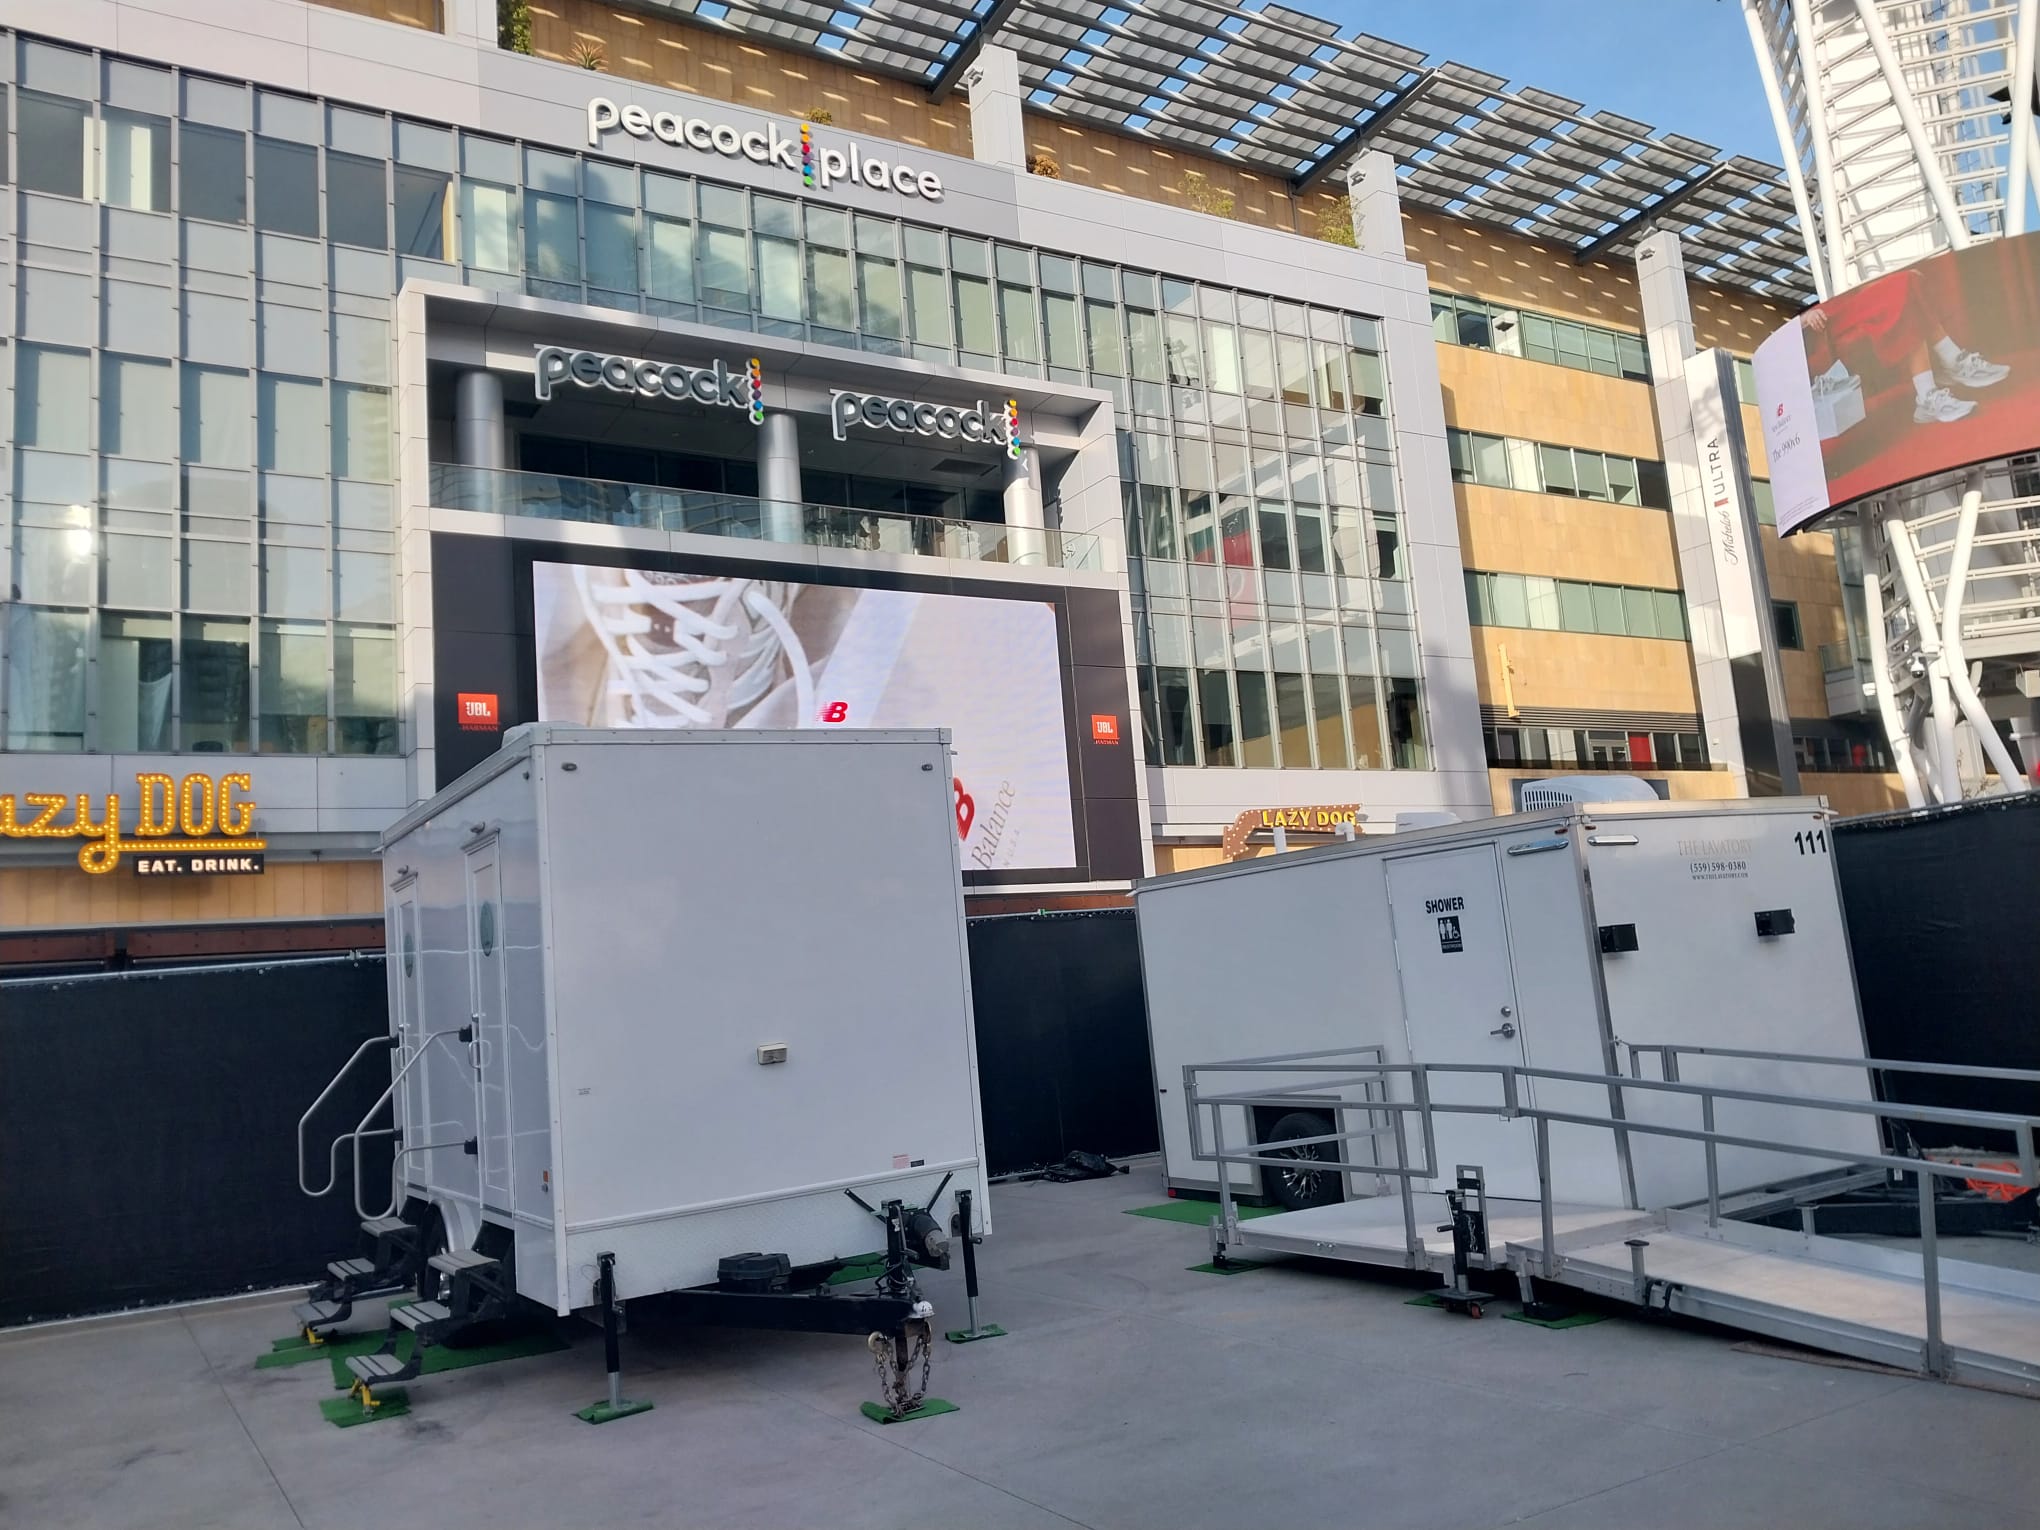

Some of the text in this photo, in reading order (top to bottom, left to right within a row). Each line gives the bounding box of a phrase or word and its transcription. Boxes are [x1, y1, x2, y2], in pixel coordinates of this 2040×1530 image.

[587, 97, 945, 202] peacock place
[534, 345, 750, 408] peacock
[831, 391, 1007, 445] peacock
[1707, 438, 1739, 565] Michelob ULTRA
[465, 701, 491, 717] JBL
[1096, 721, 1114, 734] JBL
[134, 773, 256, 836] DOG
[971, 780, 1016, 870] Balance
[1262, 810, 1357, 827] LAZY DOG
[1678, 838, 1752, 856] THE LAVATORY
[1794, 829, 1827, 855] 111
[138, 857, 259, 873] EAT. DRINK.
[1425, 896, 1465, 914] SHOWER
